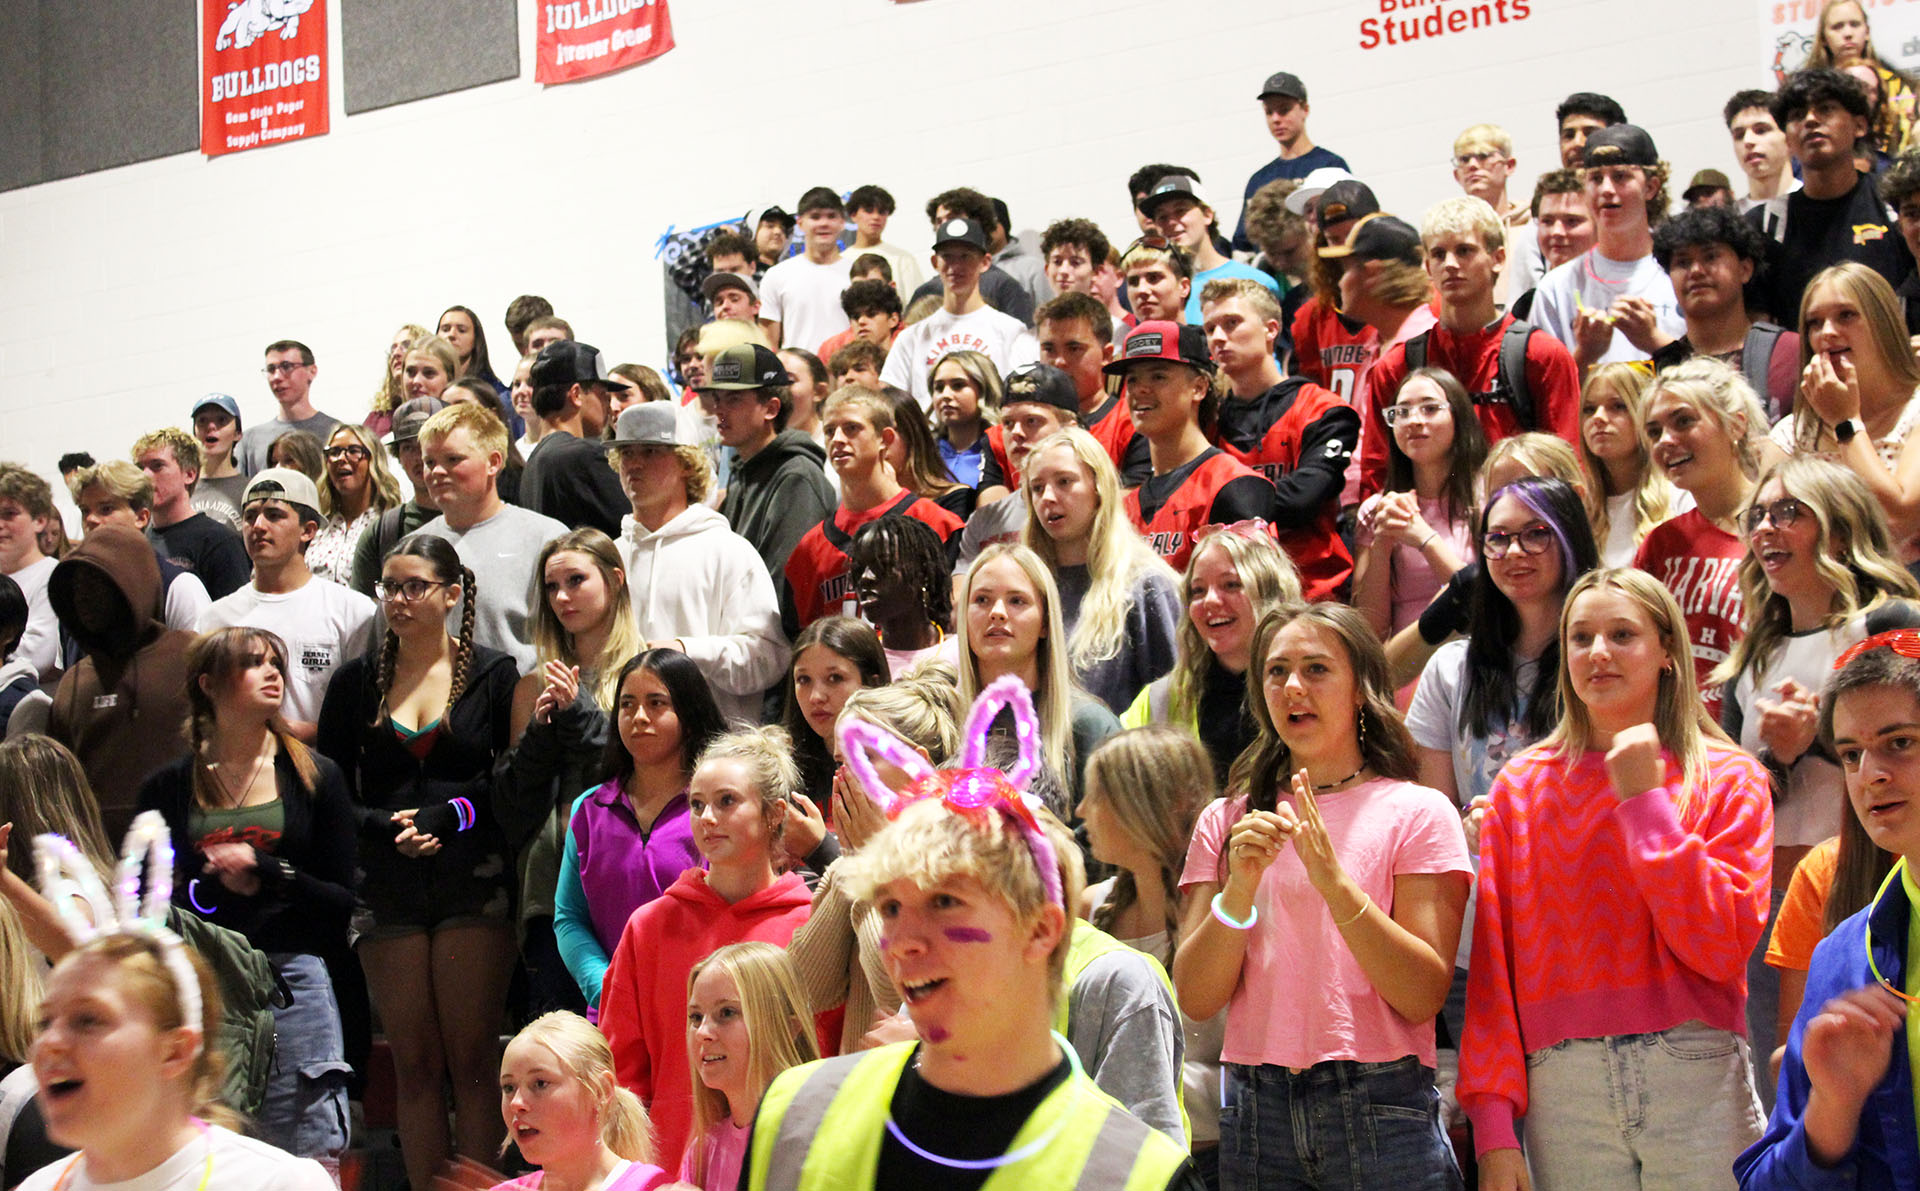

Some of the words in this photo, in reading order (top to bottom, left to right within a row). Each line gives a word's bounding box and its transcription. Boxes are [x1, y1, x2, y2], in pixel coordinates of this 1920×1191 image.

[1359, 0, 1531, 50] Students
[211, 54, 320, 103] BULLDOGS
[250, 105, 273, 120] State
[276, 99, 305, 115] Paper
[226, 131, 259, 148] Supply
[260, 122, 305, 141] Company
[926, 333, 992, 366] KIMBERL
[1663, 556, 1748, 633] HARVA
[1700, 627, 1716, 645] H
[301, 658, 331, 666] GIRLS
